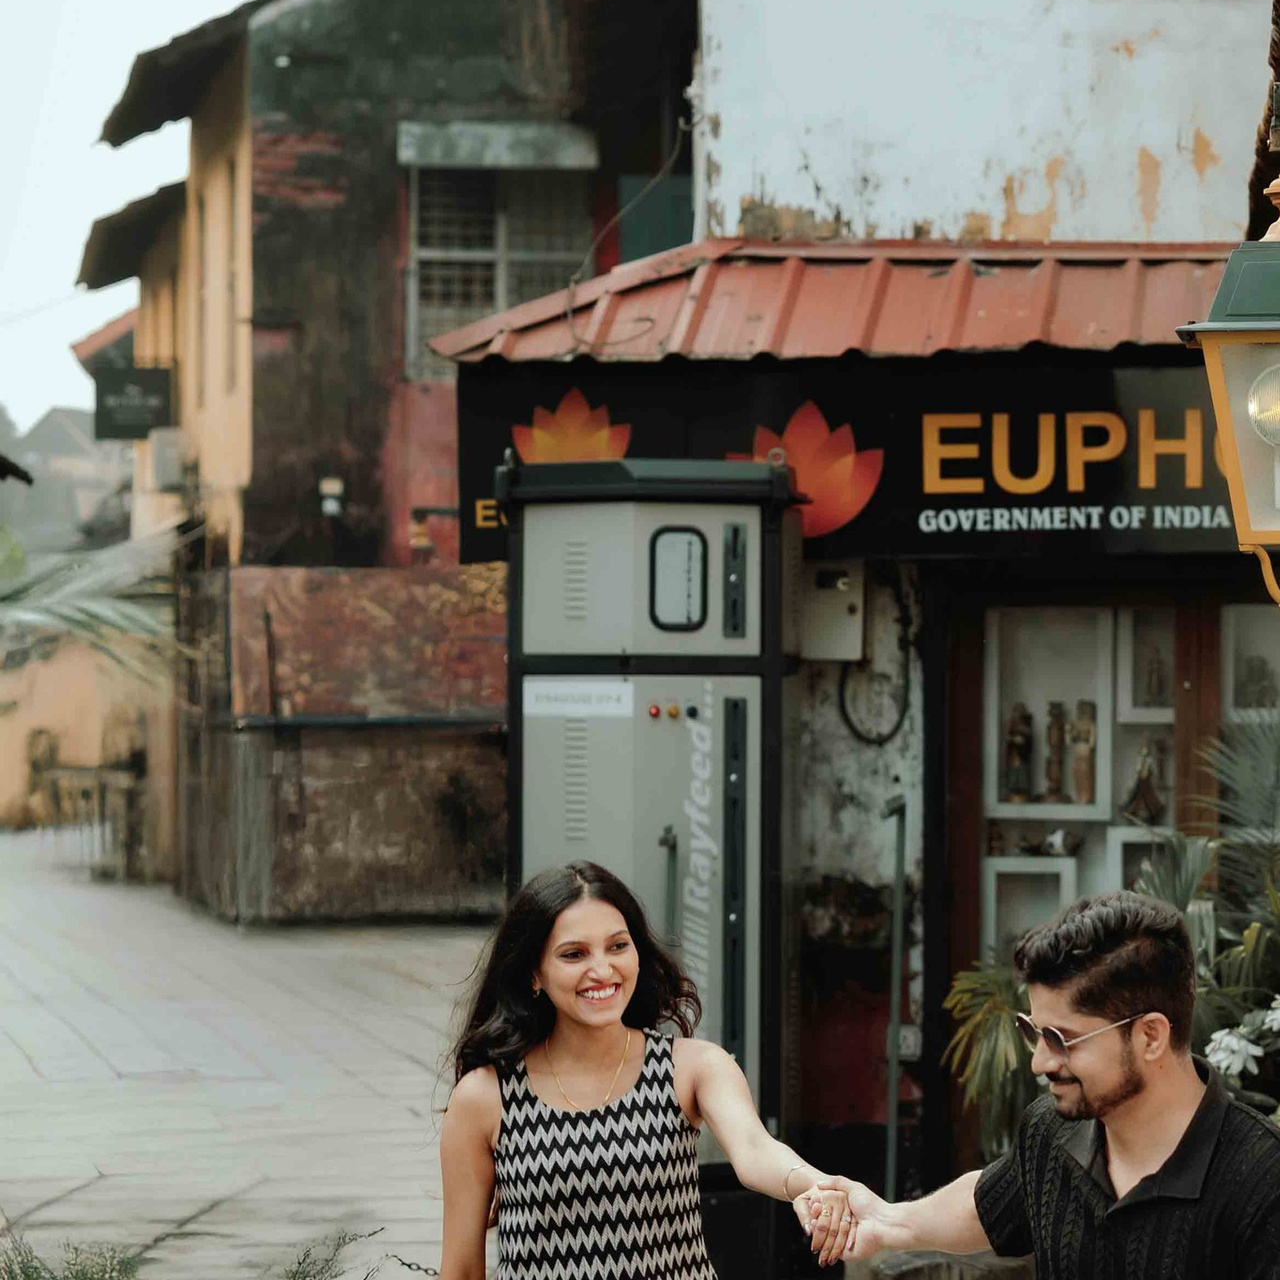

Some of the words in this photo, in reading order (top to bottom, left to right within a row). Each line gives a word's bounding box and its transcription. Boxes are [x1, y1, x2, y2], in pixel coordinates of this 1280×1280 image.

[918, 506, 1105, 532] GOVERNMENT
[1109, 505, 1147, 529] OF
[1153, 505, 1231, 528] INDIA
